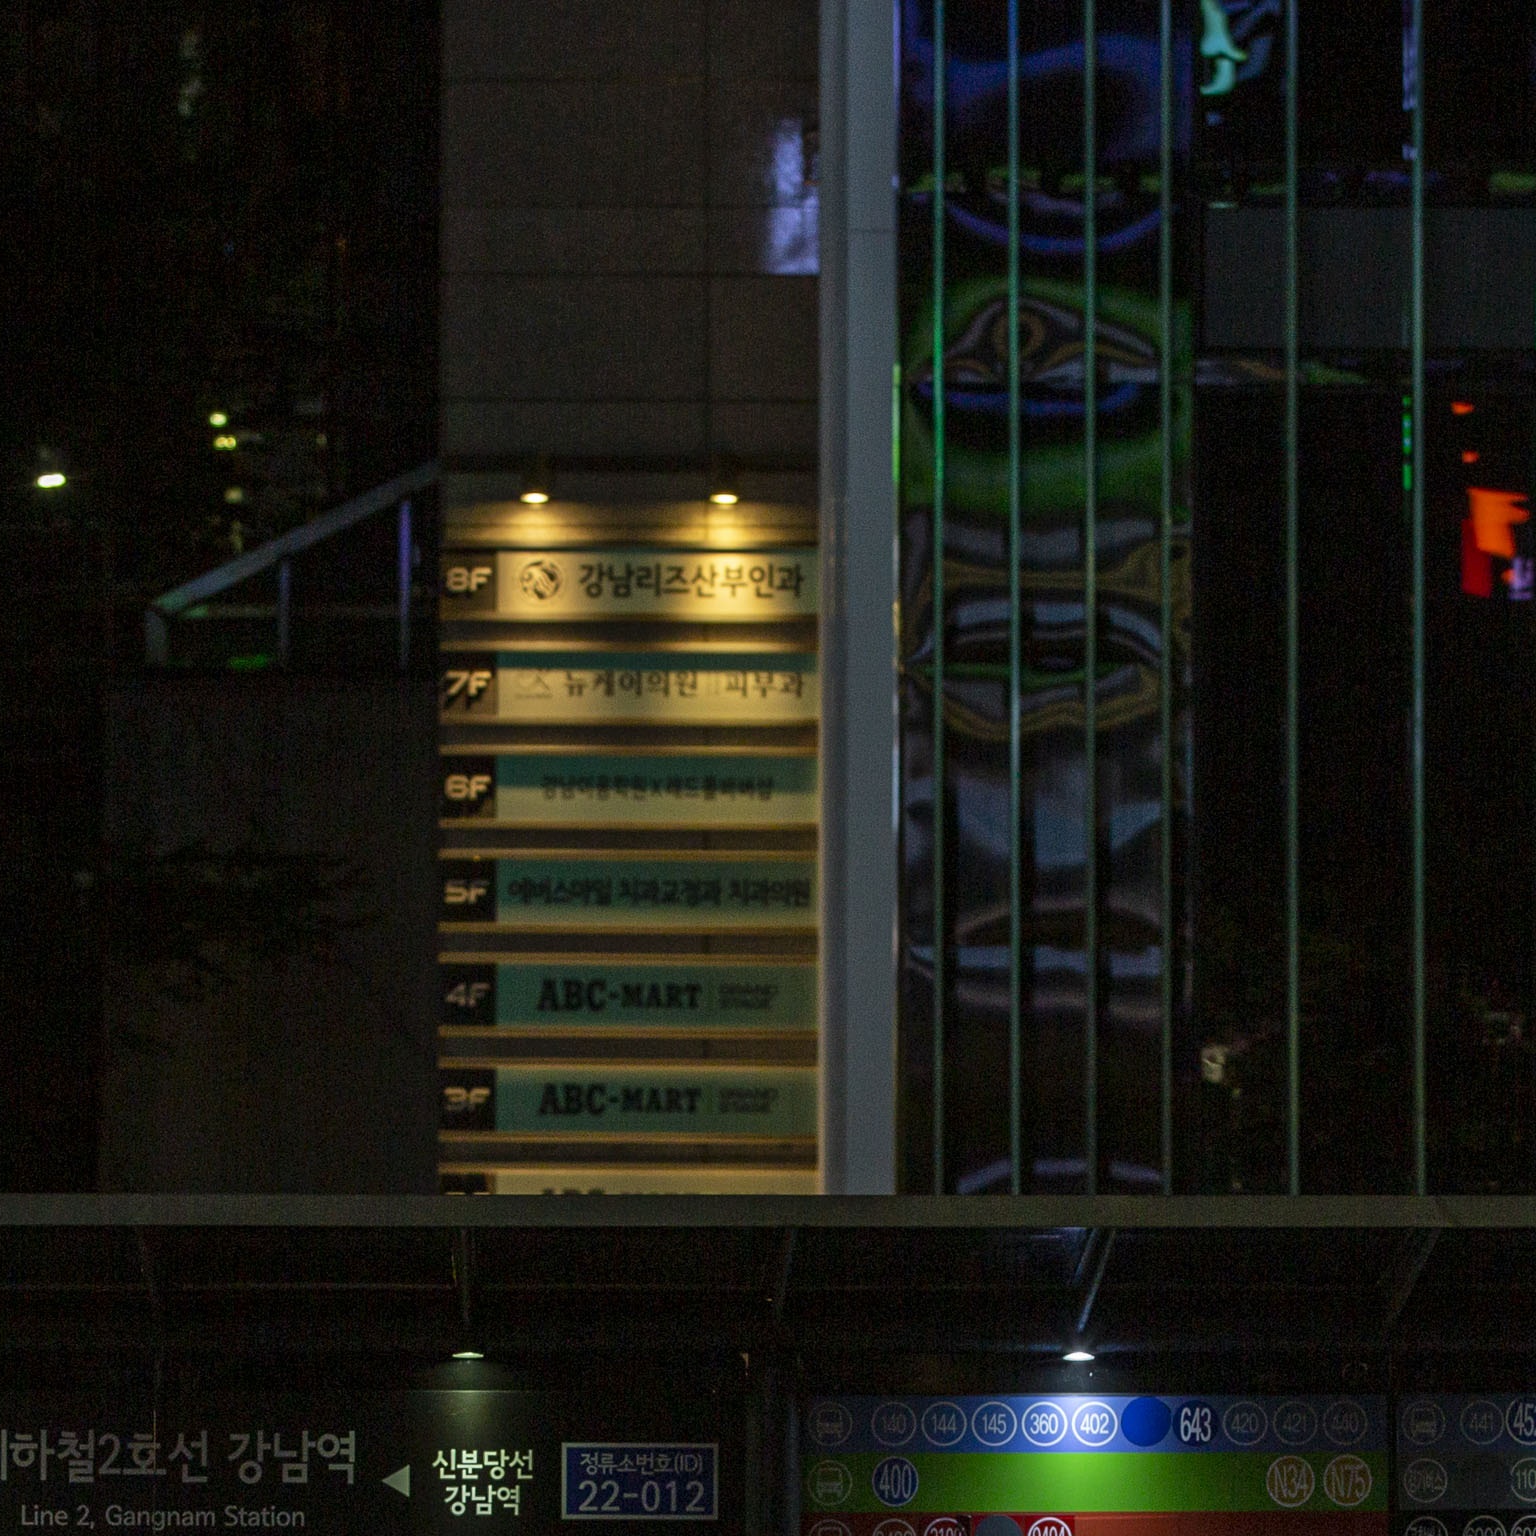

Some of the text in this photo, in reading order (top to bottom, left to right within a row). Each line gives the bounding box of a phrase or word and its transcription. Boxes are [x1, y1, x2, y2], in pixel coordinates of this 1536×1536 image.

[446, 567, 492, 593] 8F
[578, 562, 805, 598] 강남리즈산부인과
[444, 669, 492, 697] 7F
[444, 774, 492, 801] 6F
[443, 880, 490, 904] 5F
[444, 982, 491, 1008] 4F
[443, 1087, 491, 1112] 3F
[931, 1412, 957, 1434] 144
[982, 1413, 1007, 1434] 145
[1030, 1413, 1059, 1435] 360
[1080, 1414, 1109, 1435] 402
[1180, 1406, 1212, 1442] 643
[1231, 1412, 1259, 1433] 420
[227, 1430, 356, 1485] 강남역
[432, 1449, 533, 1480] 신분당선
[581, 1453, 703, 1475] 정류소번호(ID)
[879, 1463, 1365, 1500] 400 N34 N75
[444, 1485, 521, 1516] 강남역
[579, 1481, 706, 1513] 22-012
[20, 1505, 305, 1532] Line 2, Gangnam Station
